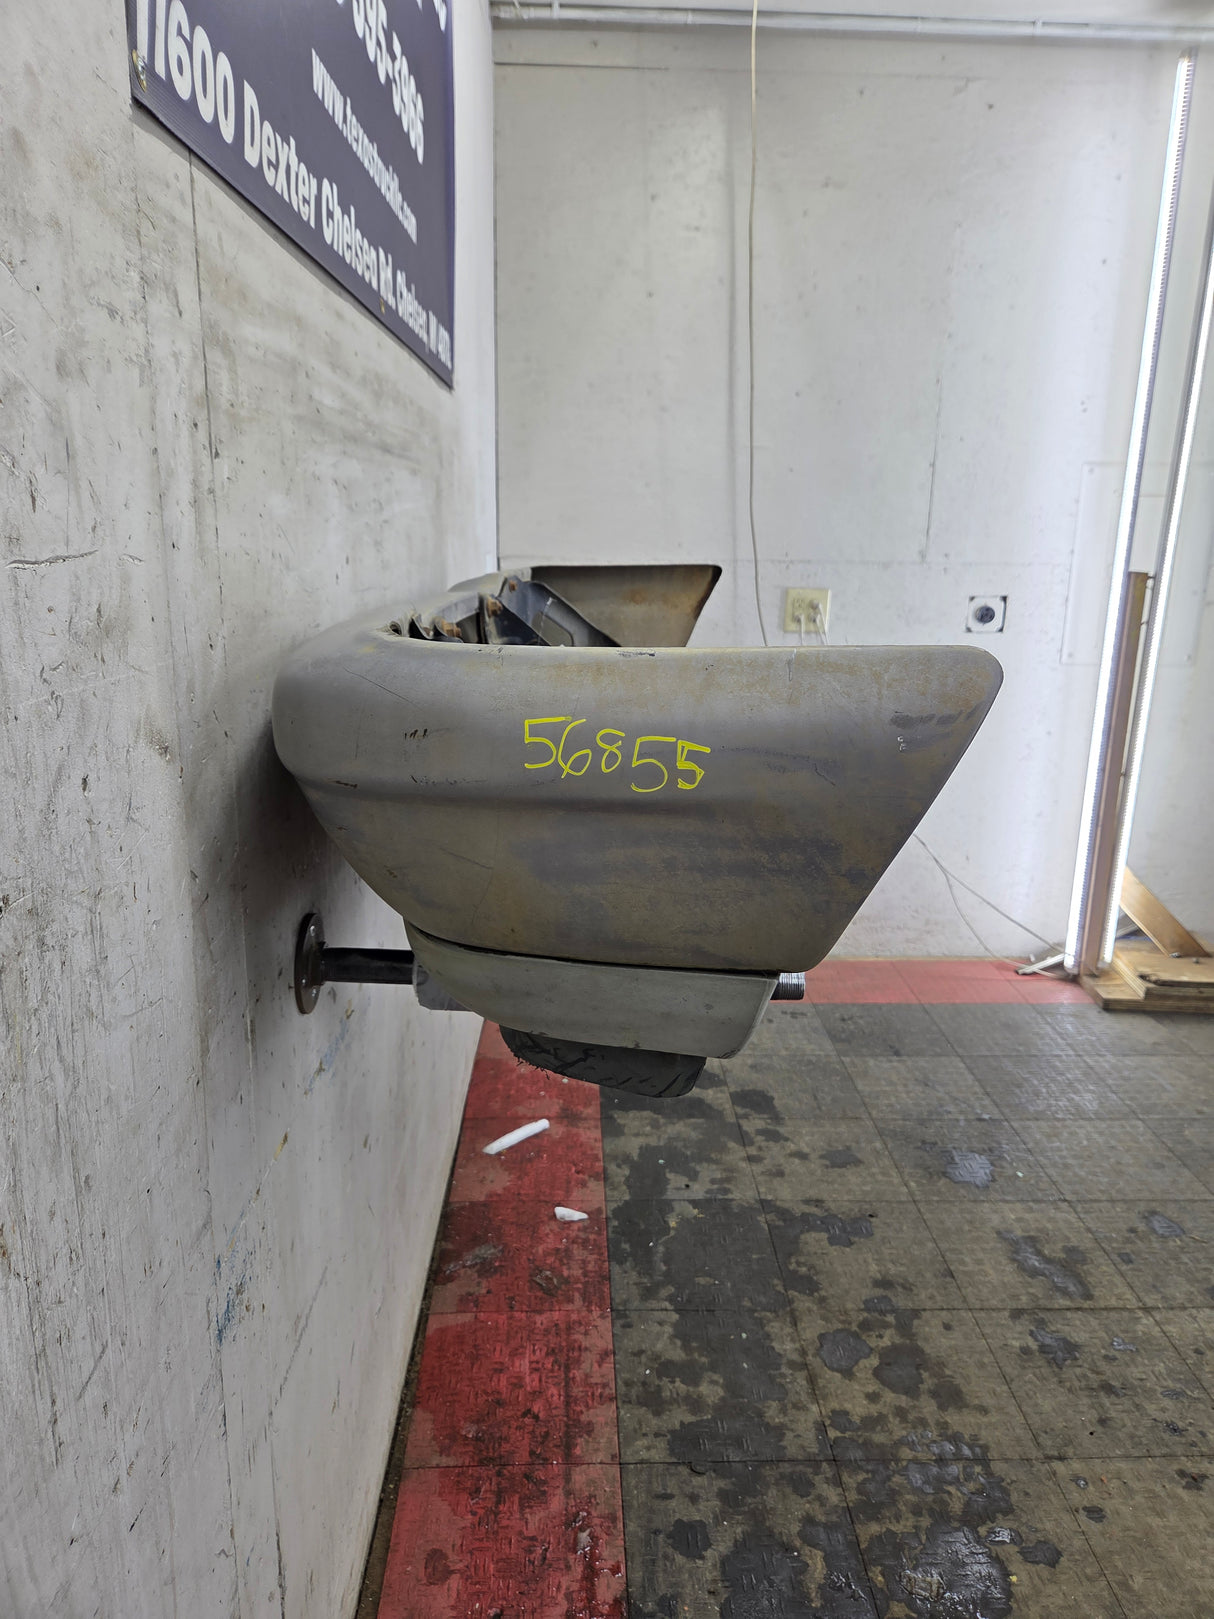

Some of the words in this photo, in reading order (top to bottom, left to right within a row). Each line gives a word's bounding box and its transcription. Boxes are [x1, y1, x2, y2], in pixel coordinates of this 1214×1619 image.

[243, 79, 318, 230] Dexter
[321, 176, 378, 292] Chelsea
[524, 715, 711, 793] 56855
